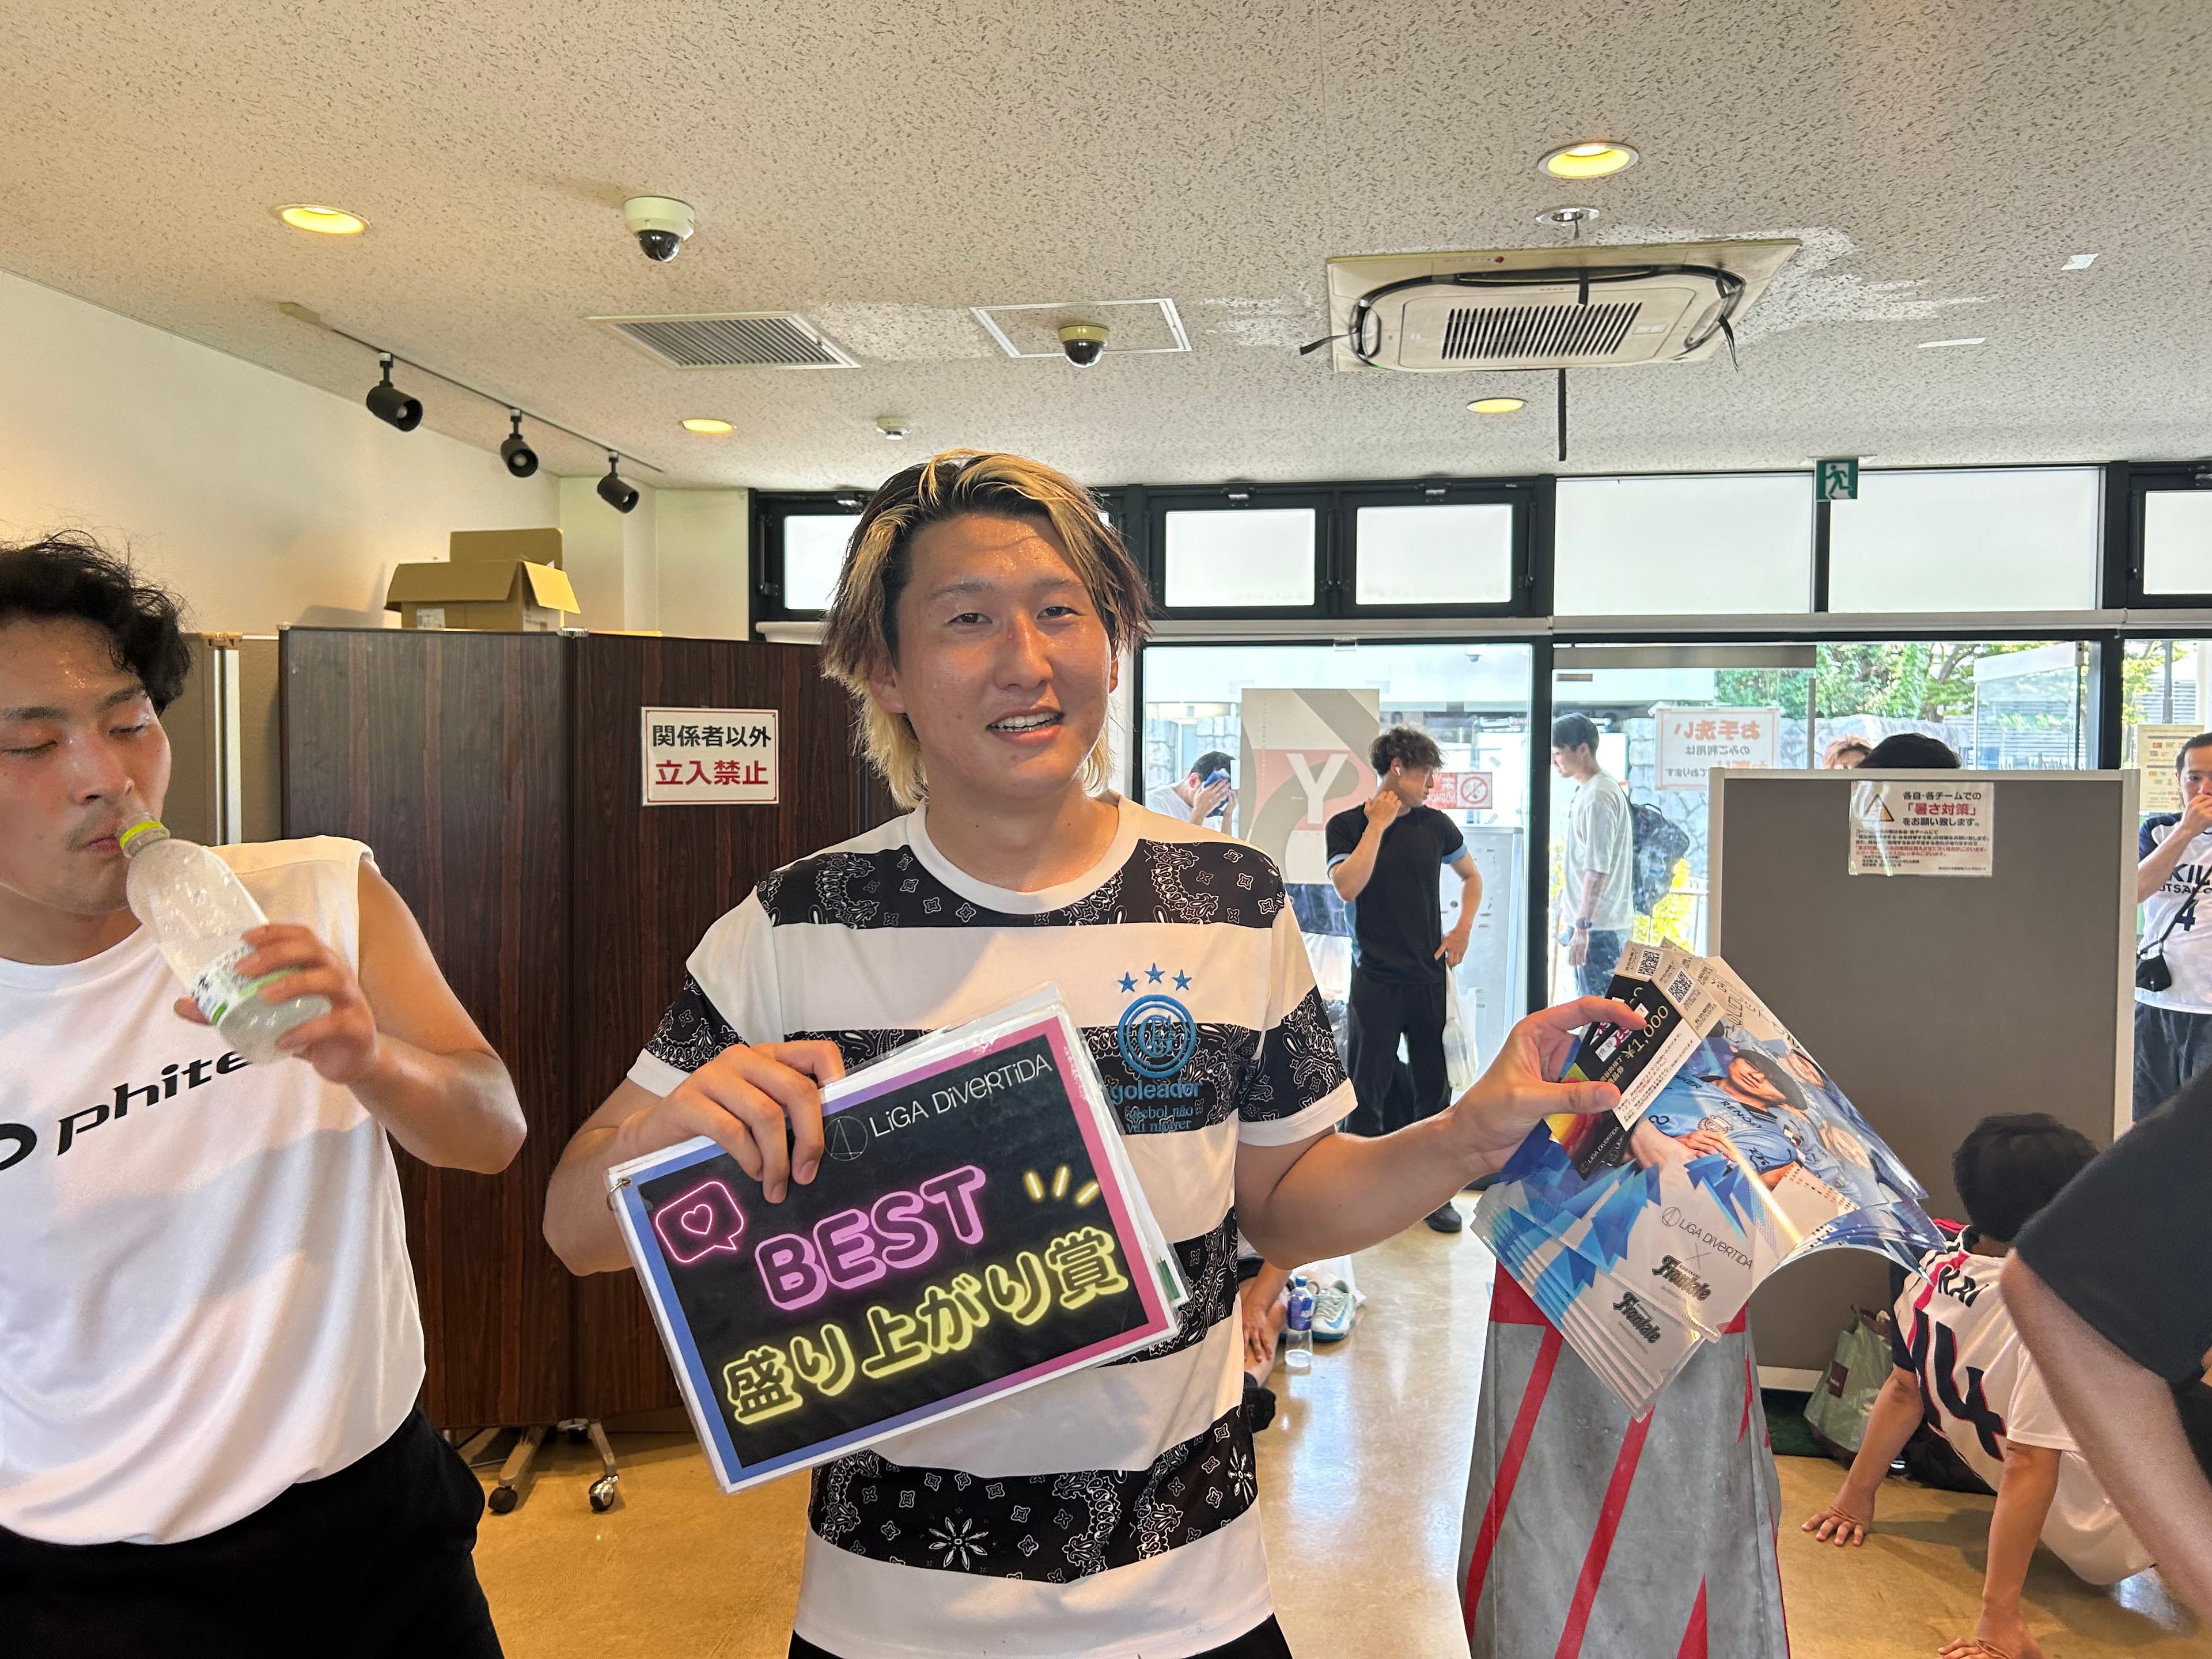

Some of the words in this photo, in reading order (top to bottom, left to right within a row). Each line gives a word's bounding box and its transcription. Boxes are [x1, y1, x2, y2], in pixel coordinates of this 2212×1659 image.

[653, 725, 771, 748] 関係者以外
[656, 760, 768, 785] 立入禁止
[1286, 753, 1349, 824] Y
[1907, 802, 1976, 816] 「暑さ対策」
[1621, 1005, 1668, 1059] ¥1,000
[58, 1050, 252, 1156] phite
[1109, 1078, 1203, 1105] goleador
[1172, 1104, 1193, 1118] não
[754, 1164, 985, 1310] BEST
[724, 1226, 1128, 1425] 盛り上がり賞
